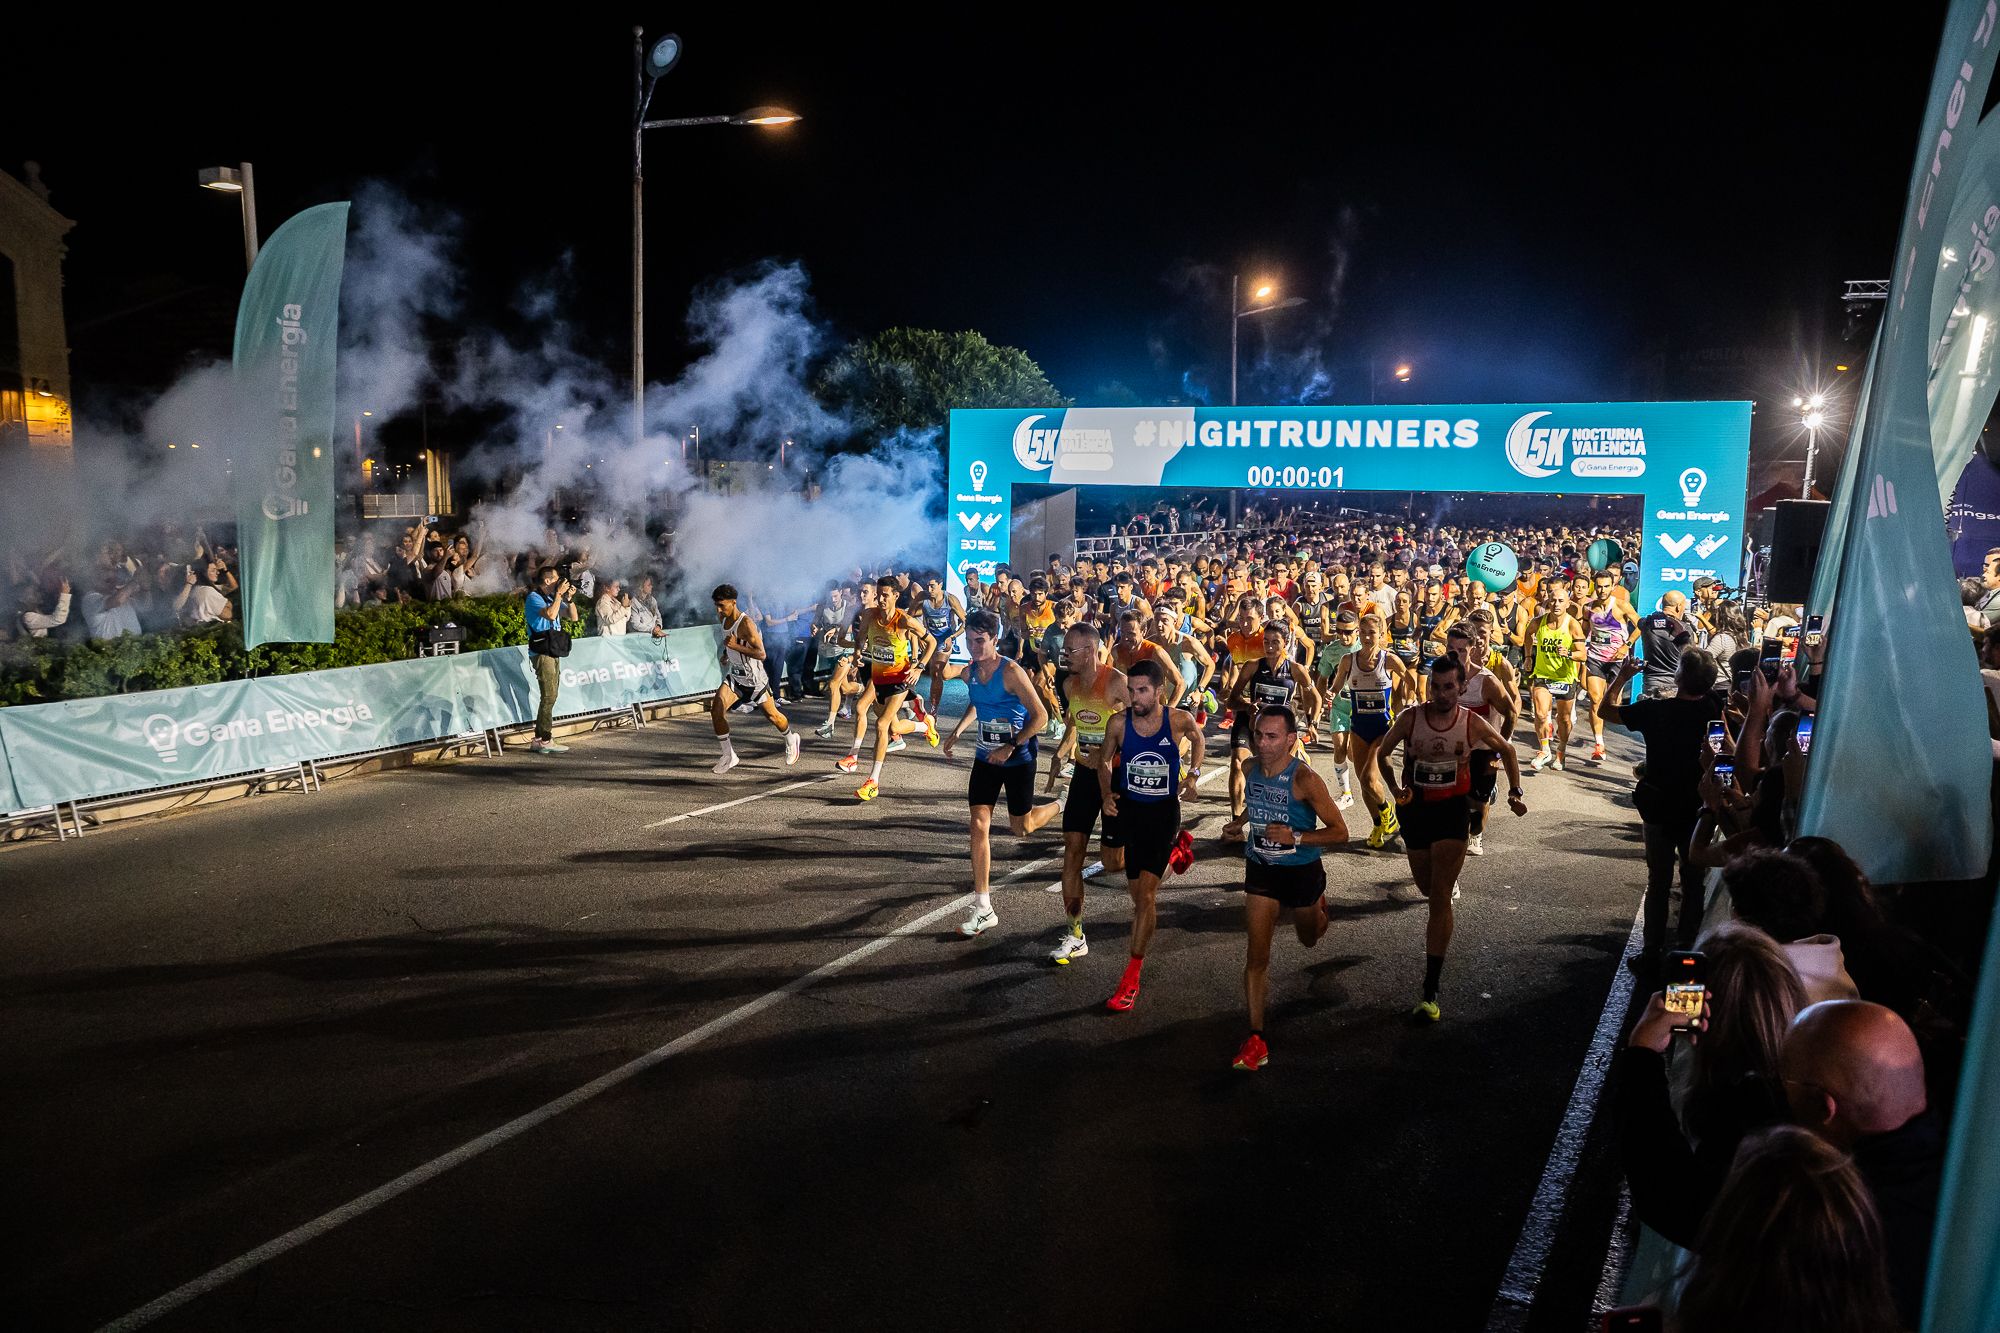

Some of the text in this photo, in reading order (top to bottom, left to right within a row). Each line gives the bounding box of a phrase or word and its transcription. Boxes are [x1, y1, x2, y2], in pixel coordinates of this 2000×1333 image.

[1134, 419, 1480, 448] #NIGHTRUNNERS
[1571, 427, 1644, 441] NOCTURNA
[1571, 440, 1647, 456] VALENCIA
[1248, 465, 1345, 488] 00:00:01
[956, 493, 975, 502] Gana
[1656, 509, 1687, 521] Gana
[560, 665, 611, 688] Gana
[183, 699, 374, 747] Gana Energía
[990, 733, 1001, 741] 86
[1133, 776, 1162, 786] 8767
